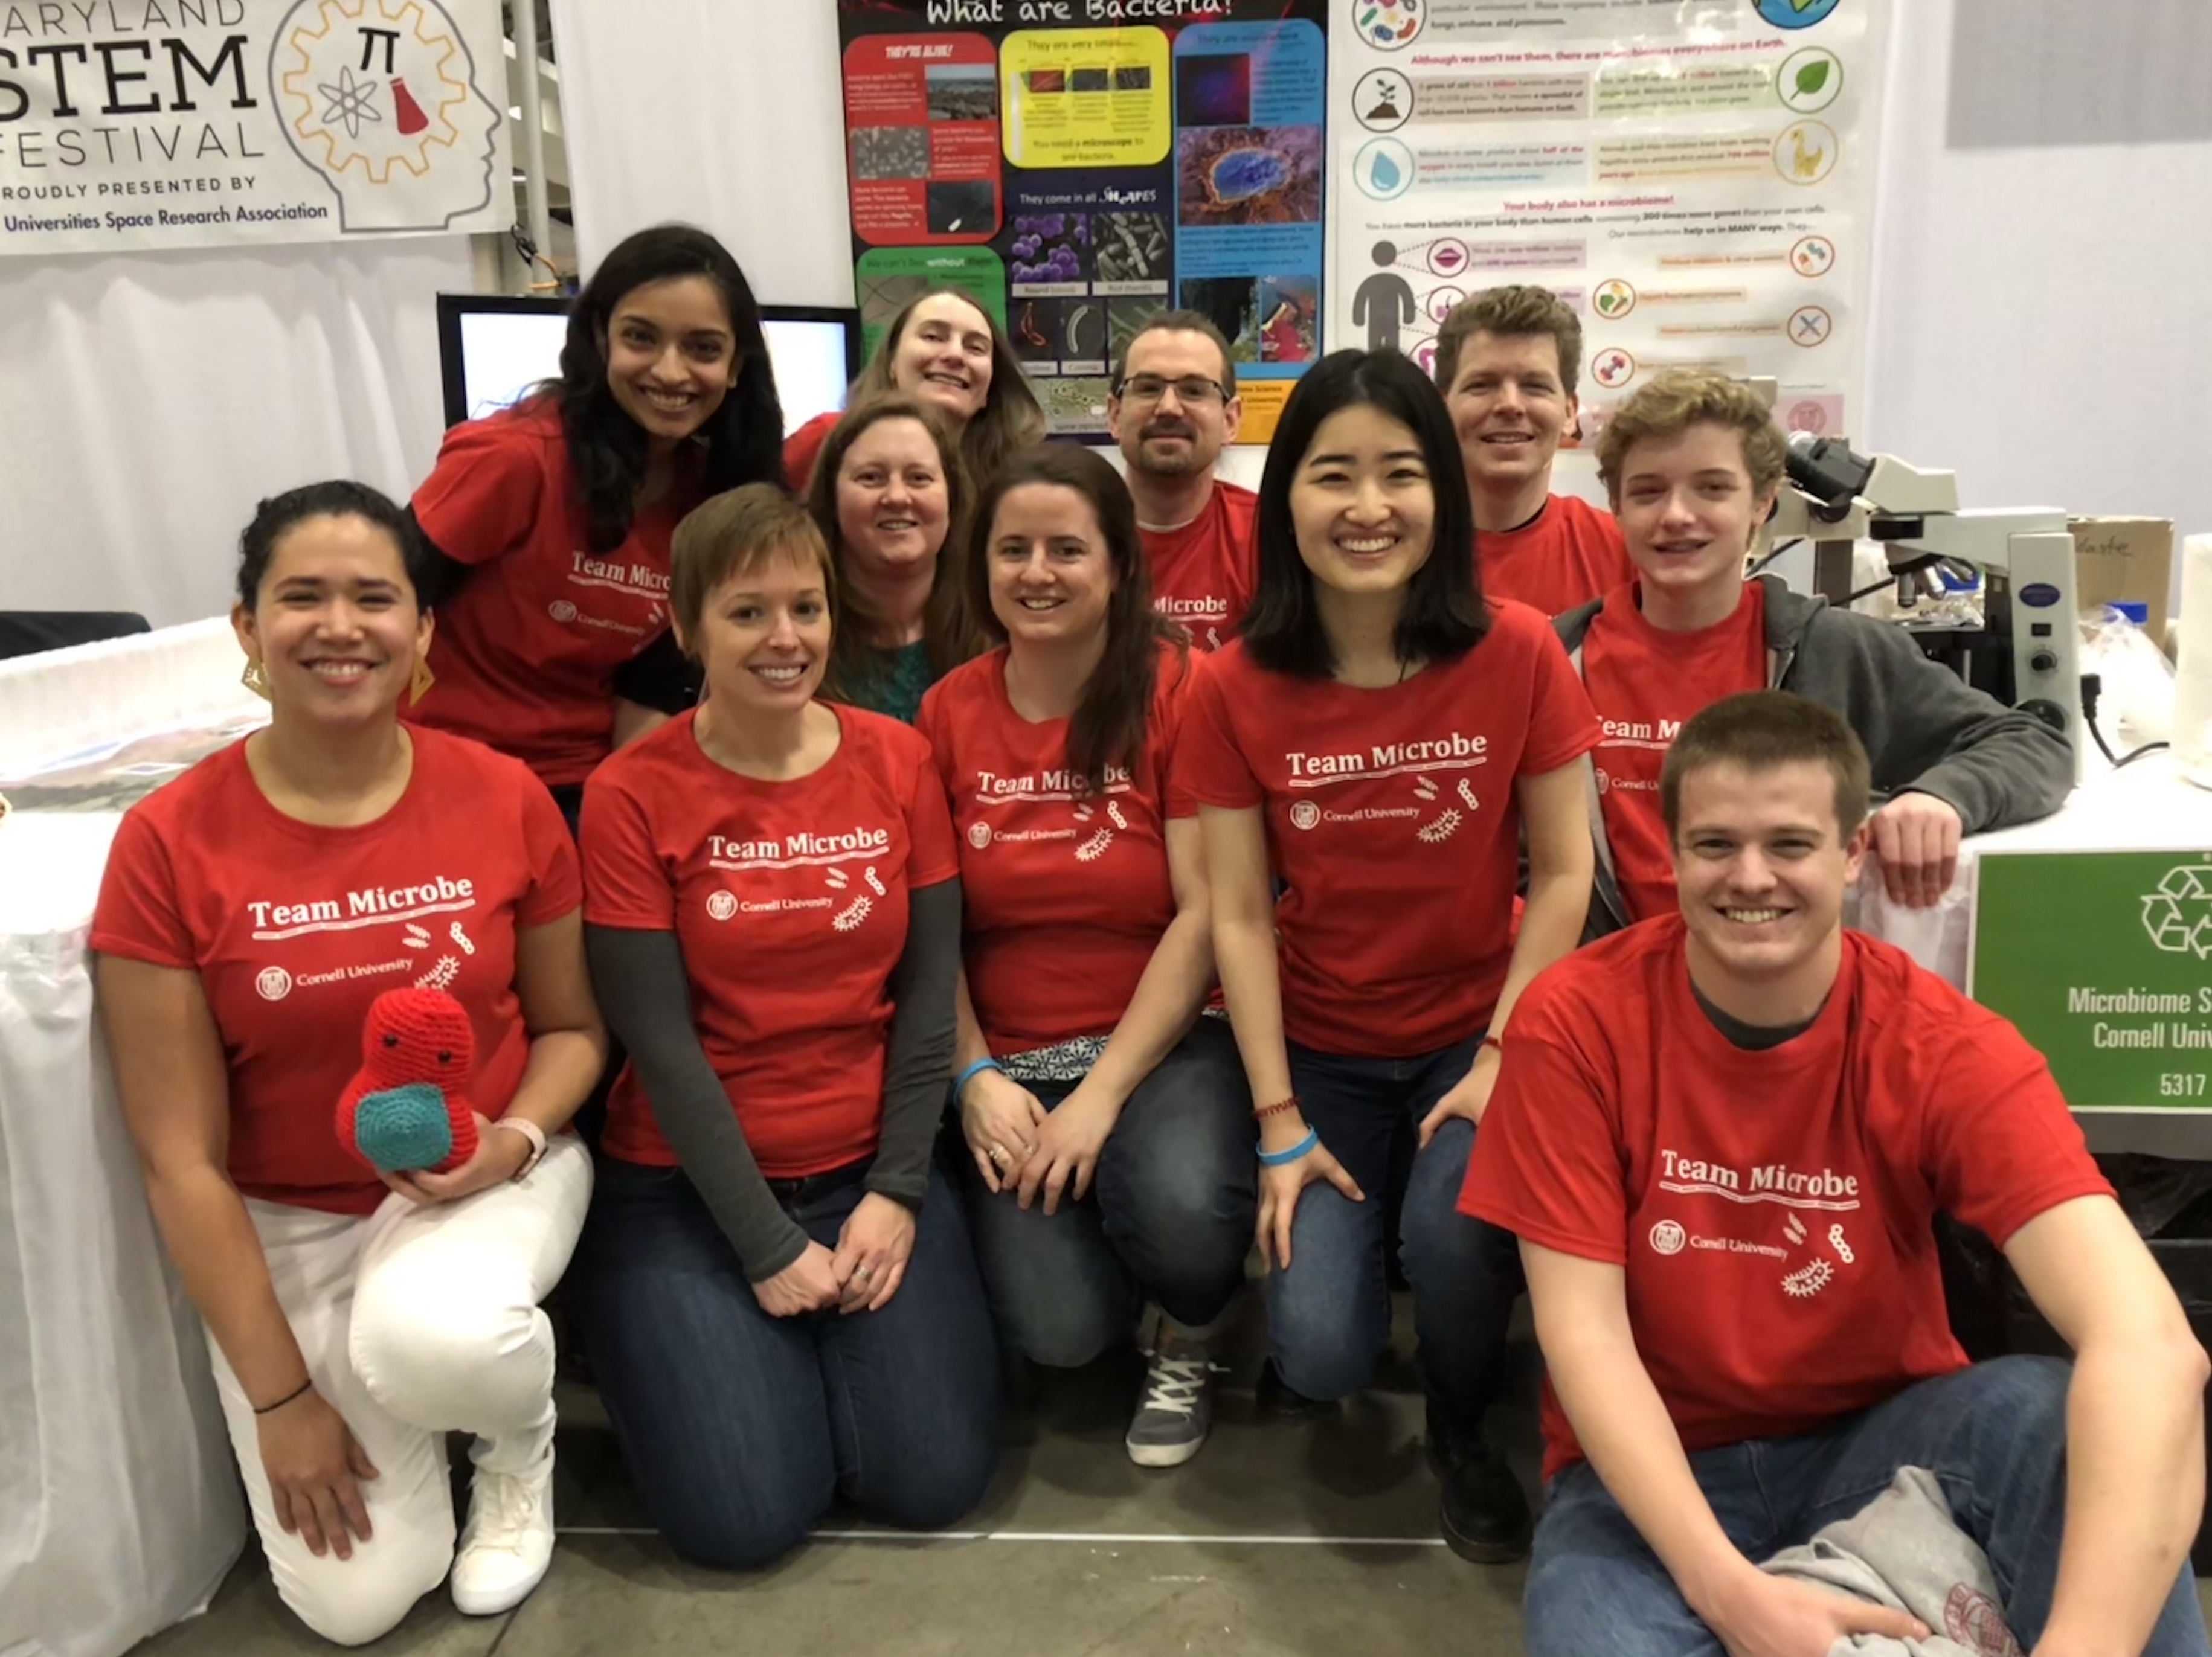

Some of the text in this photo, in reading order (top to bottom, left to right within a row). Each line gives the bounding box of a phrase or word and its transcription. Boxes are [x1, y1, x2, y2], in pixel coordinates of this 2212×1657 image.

[3, 0, 245, 37] ARYLAND
[926, 0, 1003, 24] What
[1019, 4, 1072, 21] are
[0, 34, 257, 122] STEM
[0, 122, 265, 168] ESTIVAL
[2, 176, 256, 200] ROUDLY PRESENTED BY
[1019, 193, 1043, 205] They
[1045, 194, 1072, 204] come
[1073, 193, 1082, 202] in
[1085, 193, 1097, 202] all
[4, 201, 328, 232] Universities Space Research Association
[1528, 200, 1554, 211] body
[1557, 199, 1578, 210] also
[1580, 198, 1597, 208] has
[1728, 223, 1757, 232] MANY
[927, 258, 965, 268] without
[573, 550, 672, 591] Team Micro
[1154, 594, 1227, 613] Microbe
[1595, 715, 1651, 739] eam
[1286, 732, 1488, 776] Team Microbe
[977, 763, 1131, 794] Team Micbe
[1323, 806, 1421, 822] Cornell University
[707, 826, 888, 859] Team Microbe
[994, 828, 1077, 842] Cornell University
[247, 875, 474, 928] Team Microbe
[739, 896, 834, 912] Cornell University
[297, 958, 414, 987] Cornell University
[2068, 986, 2191, 1013] Microbiome
[2093, 1022, 2164, 1049] Cornell
[2160, 1073, 2207, 1097] 5317
[1661, 1149, 1859, 1197] Team Microbe
[1729, 1239, 1789, 1261] University
